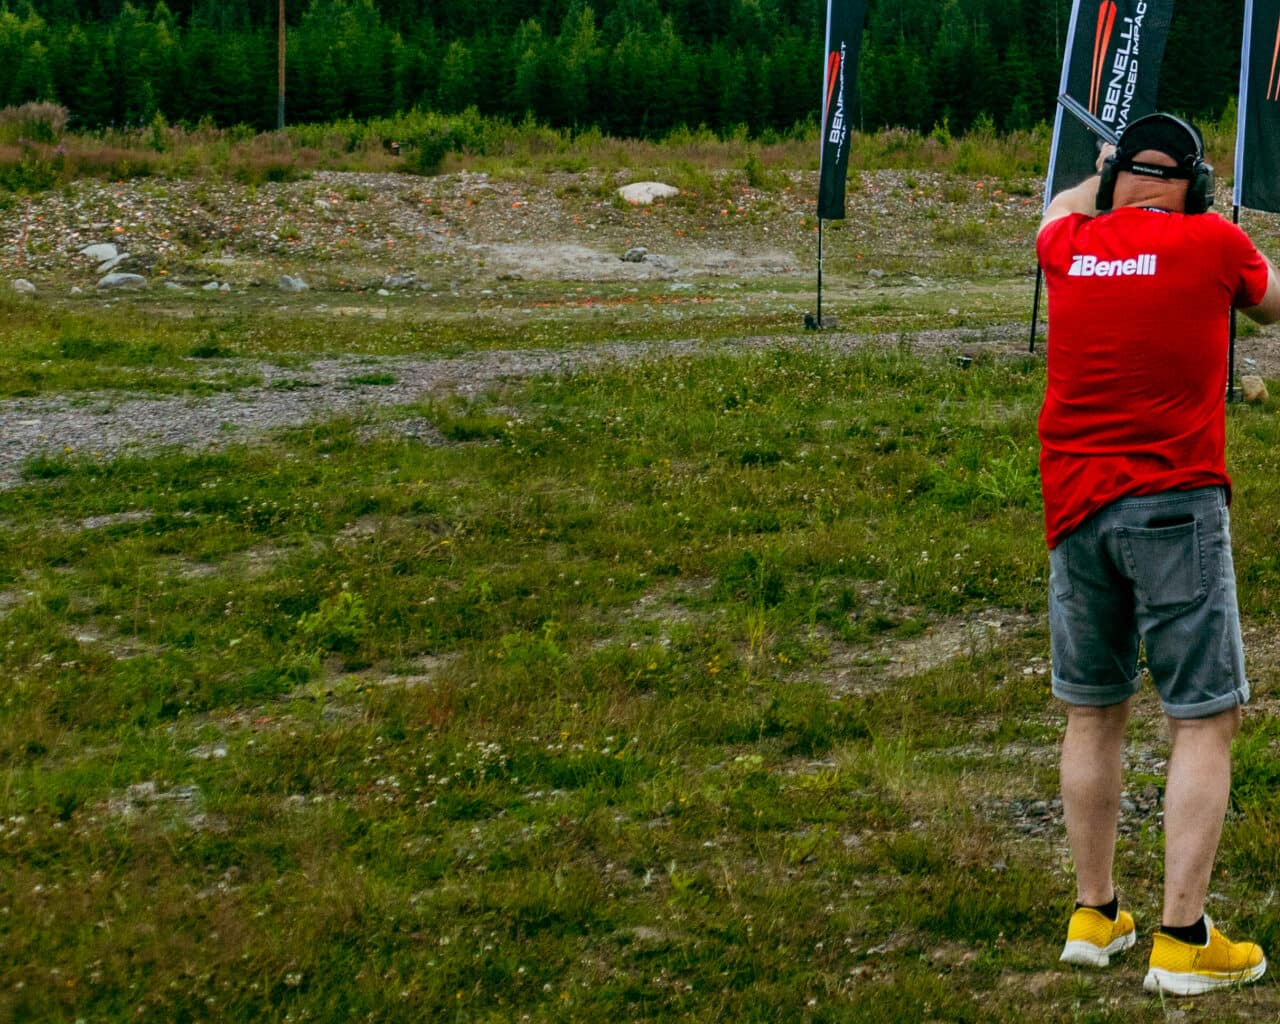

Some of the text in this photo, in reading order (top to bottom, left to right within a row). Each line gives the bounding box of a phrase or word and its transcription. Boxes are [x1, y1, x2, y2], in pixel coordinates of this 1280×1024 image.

[1101, 17, 1133, 123] BENELLI
[1115, 59, 1138, 138] DVANCED
[1080, 254, 1157, 276] Benelli
